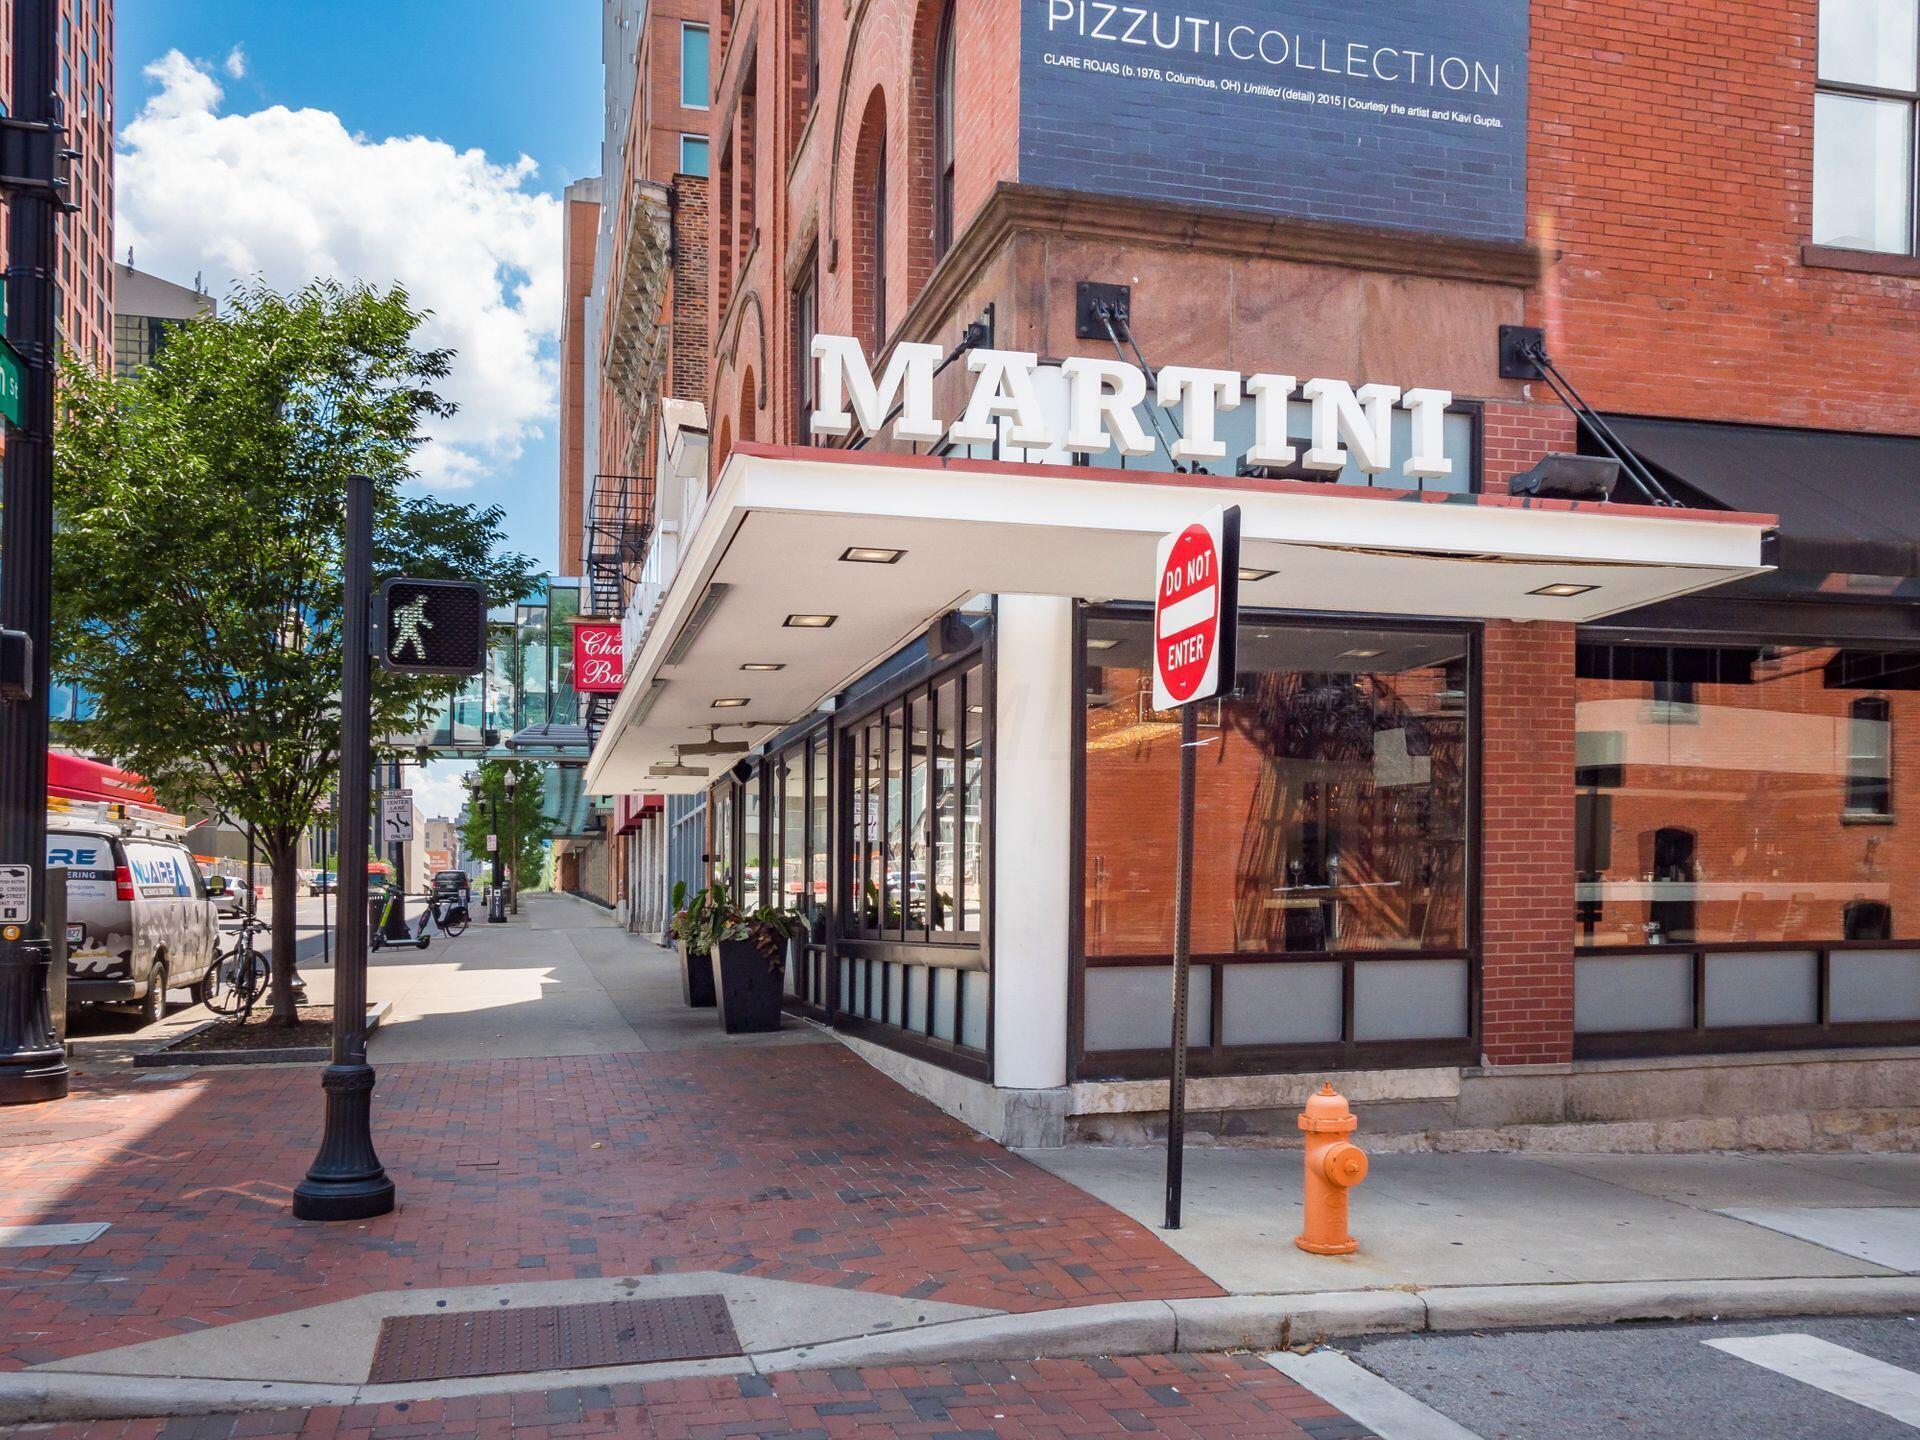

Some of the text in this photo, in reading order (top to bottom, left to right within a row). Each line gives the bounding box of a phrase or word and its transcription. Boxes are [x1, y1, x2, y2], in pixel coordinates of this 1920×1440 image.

[1043, 53, 1081, 69] CLARE
[1083, 59, 1120, 74] ROJAS
[1165, 71, 1218, 89] Columbus,
[1220, 79, 1241, 94] OH)
[1243, 83, 1281, 97] Untitled
[1282, 88, 1315, 104] (detail)
[1317, 93, 1341, 106] 2015
[1348, 97, 1389, 114] Courtesy
[1391, 103, 1405, 114] the
[1408, 106, 1430, 118] artist
[1432, 110, 1450, 121] and
[1452, 111, 1471, 123] Kavi
[1473, 114, 1503, 128] Gupta.
[810, 334, 1452, 477] MARTINI
[1166, 549, 1211, 597] DO NOT
[1167, 633, 1204, 671] ENTER
